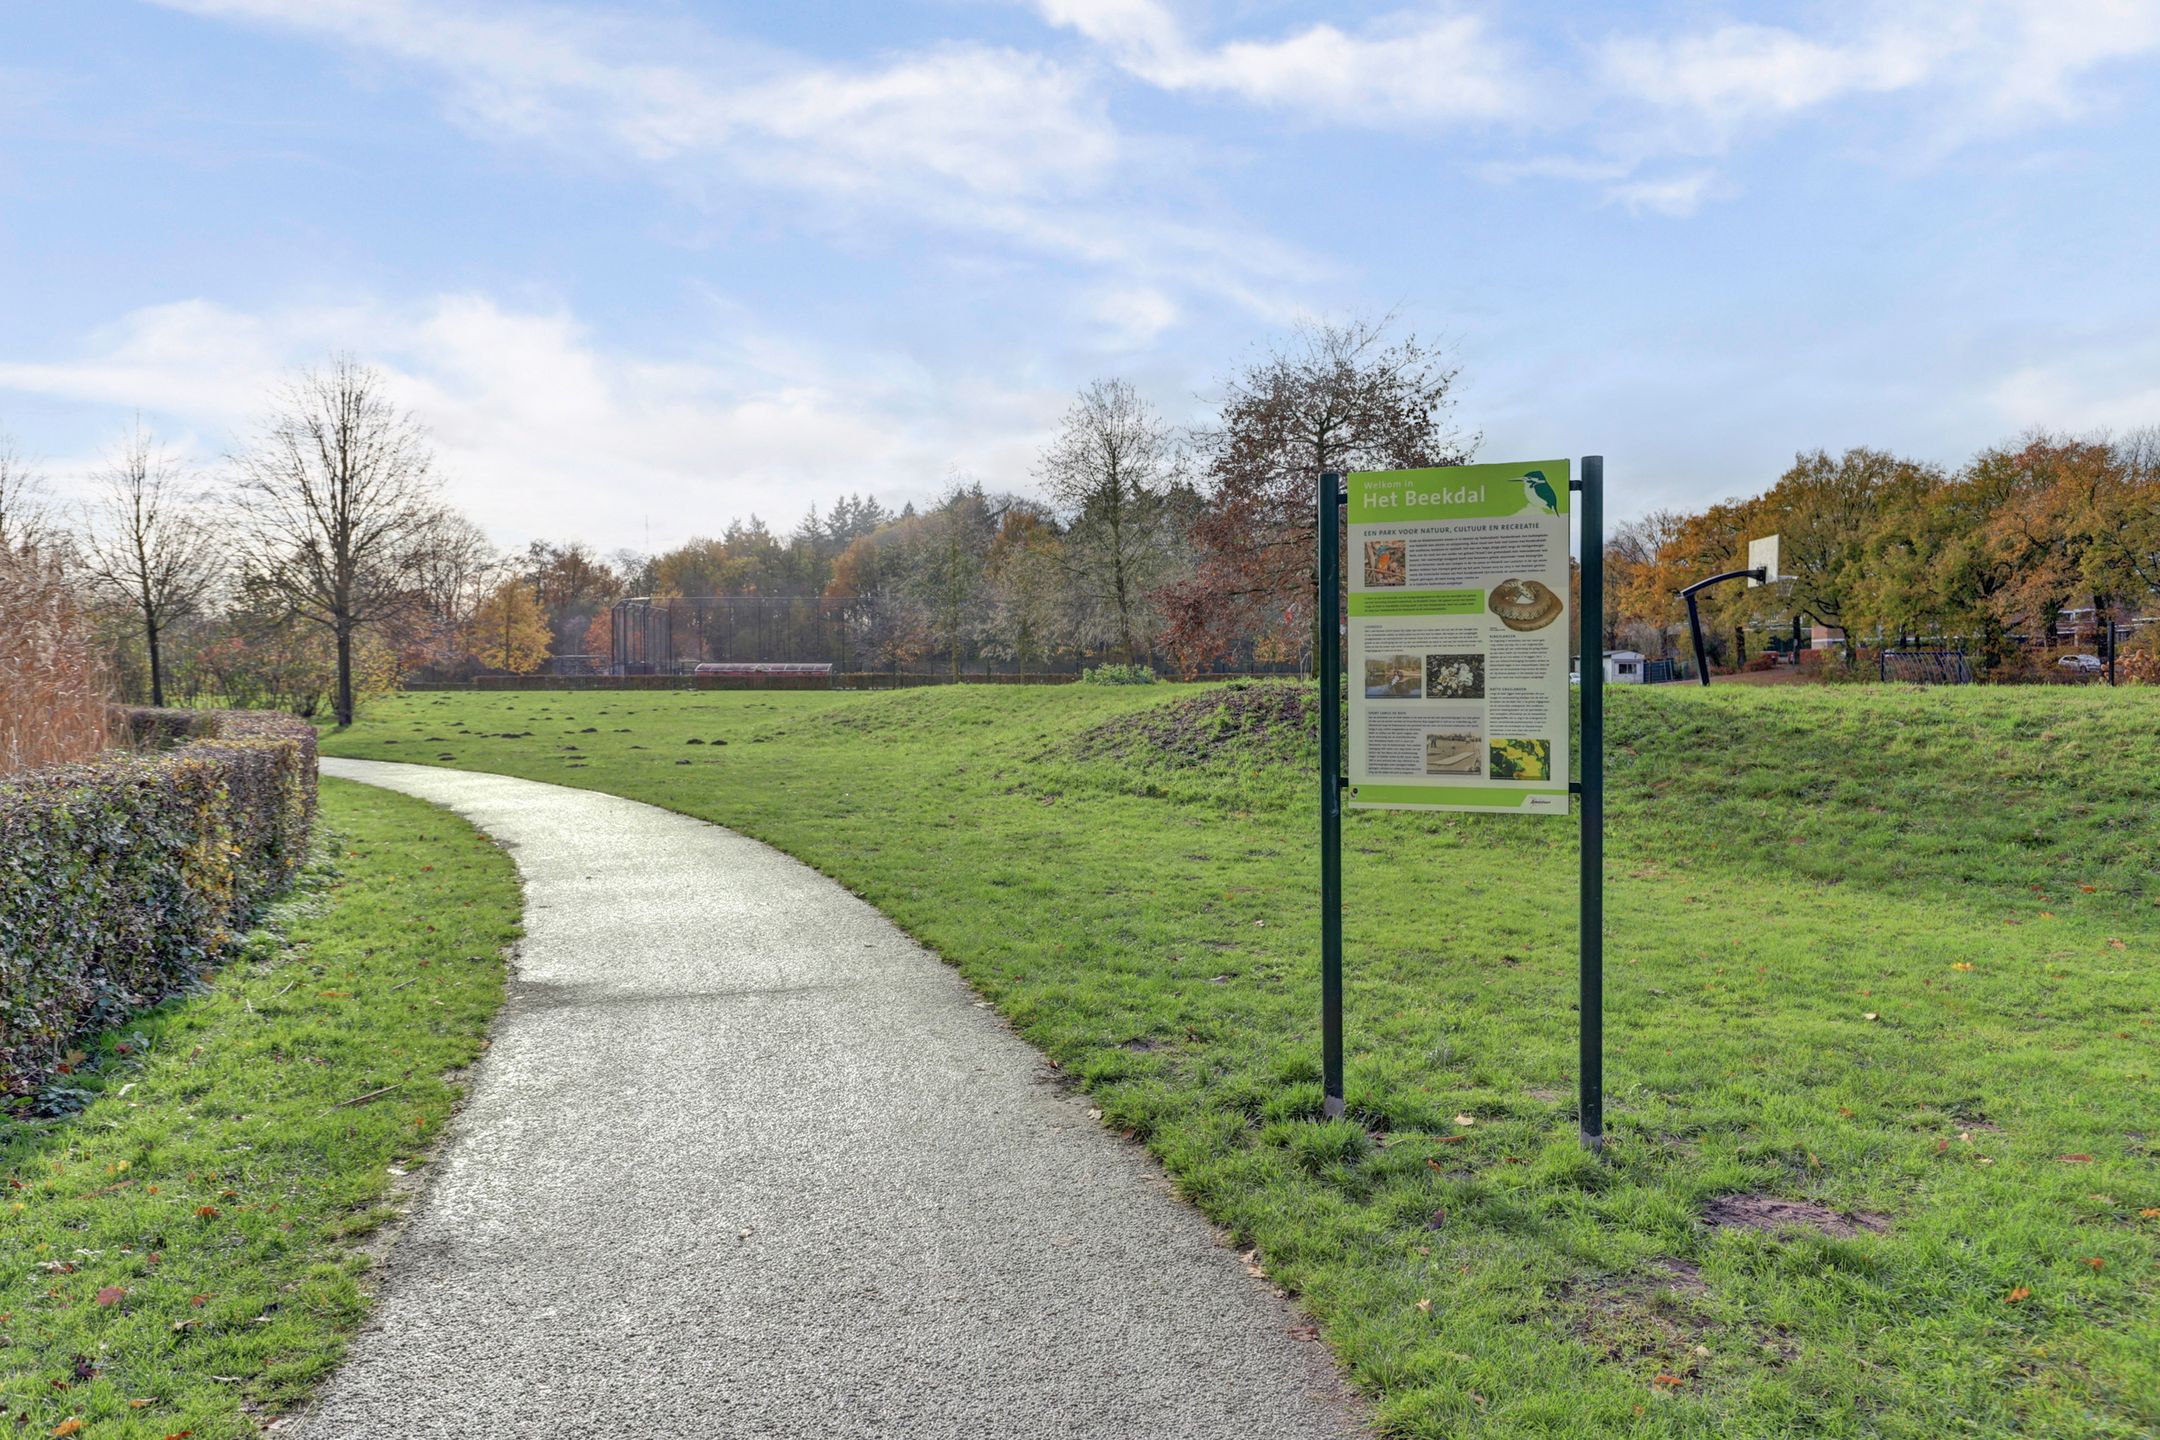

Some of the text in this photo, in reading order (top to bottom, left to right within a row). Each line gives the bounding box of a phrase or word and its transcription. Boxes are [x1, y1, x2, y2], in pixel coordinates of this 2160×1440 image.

[1363, 479, 1414, 490] Welkom in
[1363, 485, 1485, 509] Het Beekdal
[1501, 522, 1540, 530] RECREATIE
